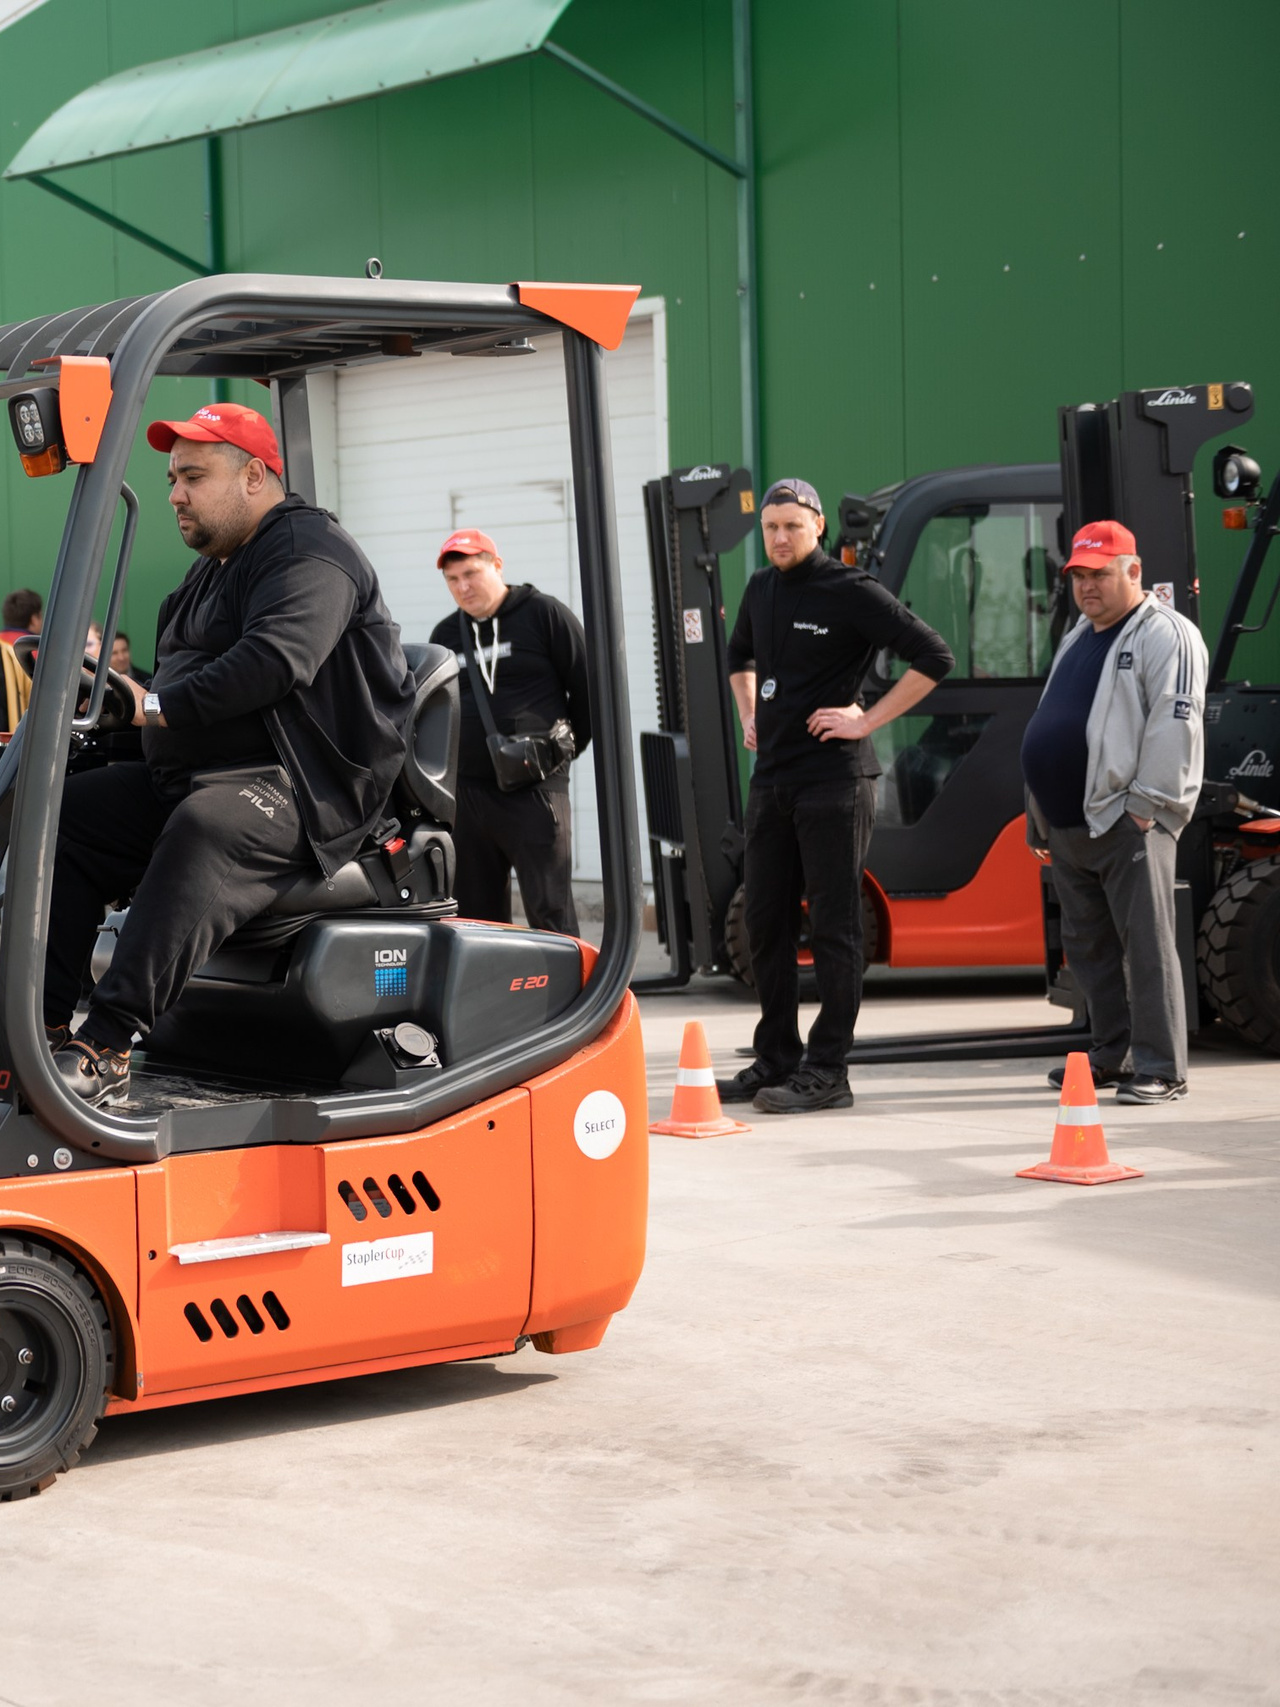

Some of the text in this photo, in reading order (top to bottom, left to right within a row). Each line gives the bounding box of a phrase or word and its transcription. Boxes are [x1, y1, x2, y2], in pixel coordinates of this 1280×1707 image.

[1146, 389, 1197, 406] Linde
[680, 465, 722, 482] Linde
[1229, 750, 1274, 777] Linde
[249, 783, 286, 809] JOURNEY
[255, 777, 288, 806] SUMMER
[238, 788, 275, 819] FILA
[374, 949, 407, 963] ION
[346, 1247, 405, 1266] StaplerCup
